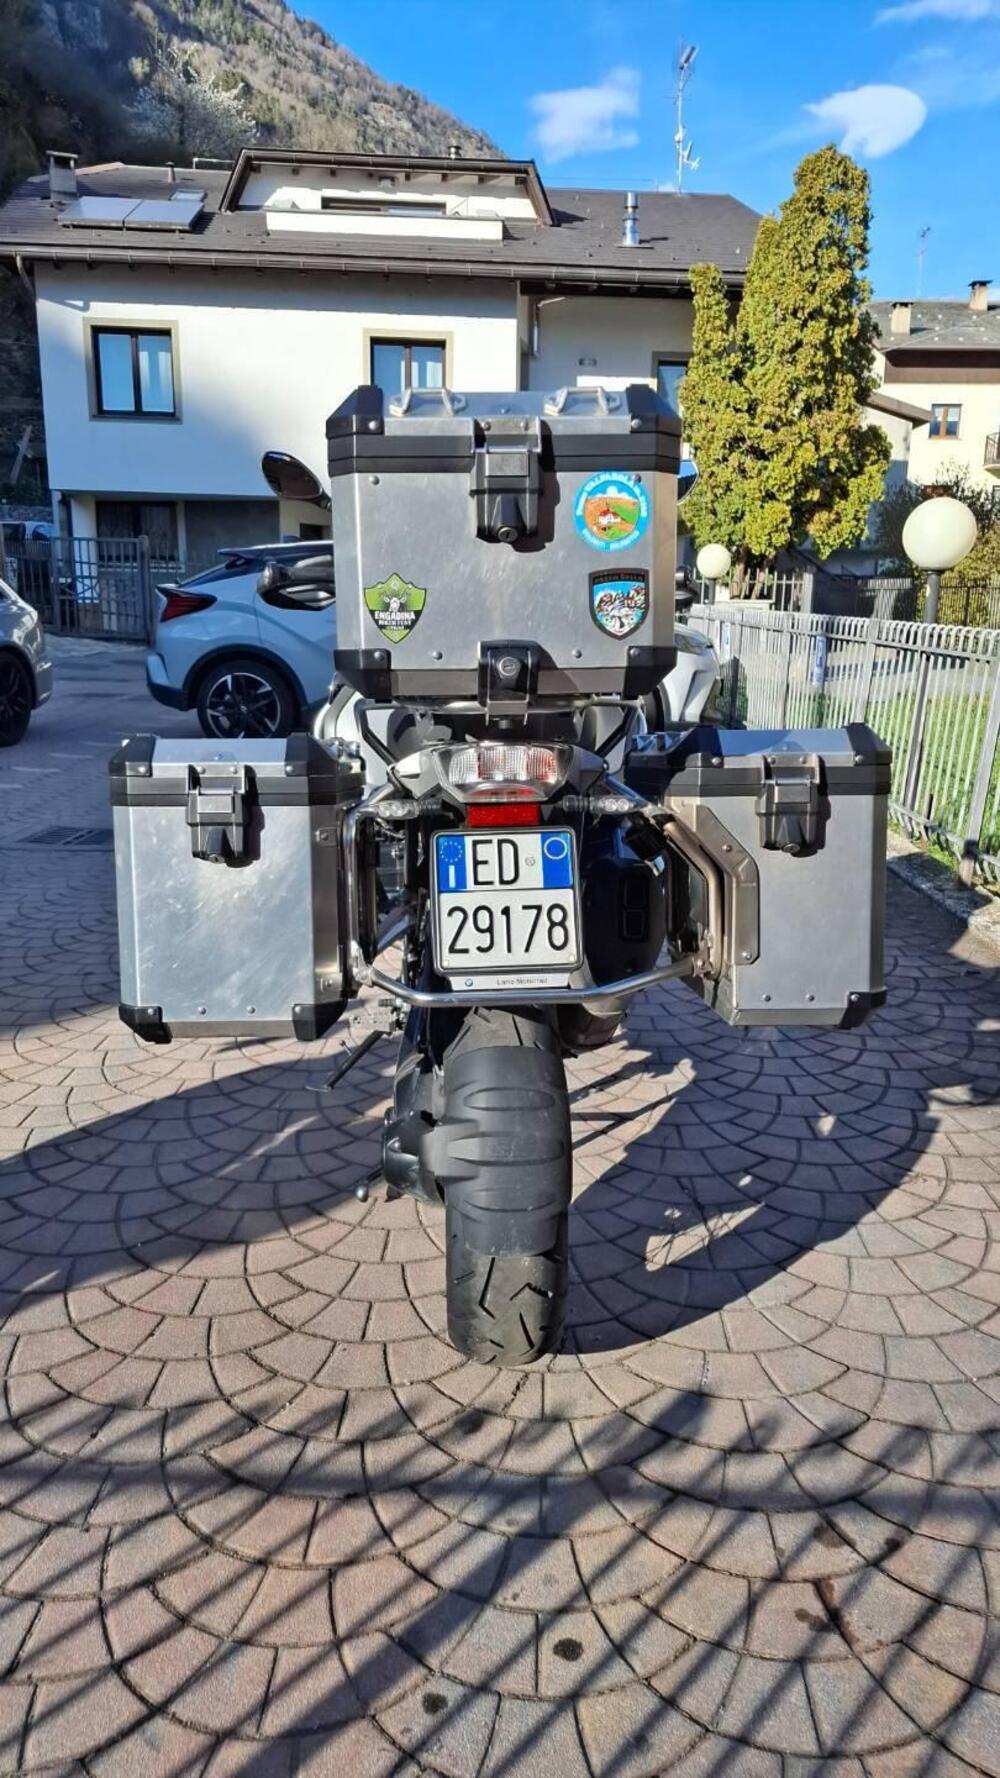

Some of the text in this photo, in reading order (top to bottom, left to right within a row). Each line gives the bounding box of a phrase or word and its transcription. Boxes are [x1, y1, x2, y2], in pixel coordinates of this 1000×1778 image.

[374, 611, 416, 620] ENGADINA
[471, 838, 520, 886] ED
[446, 903, 569, 954] 29178
